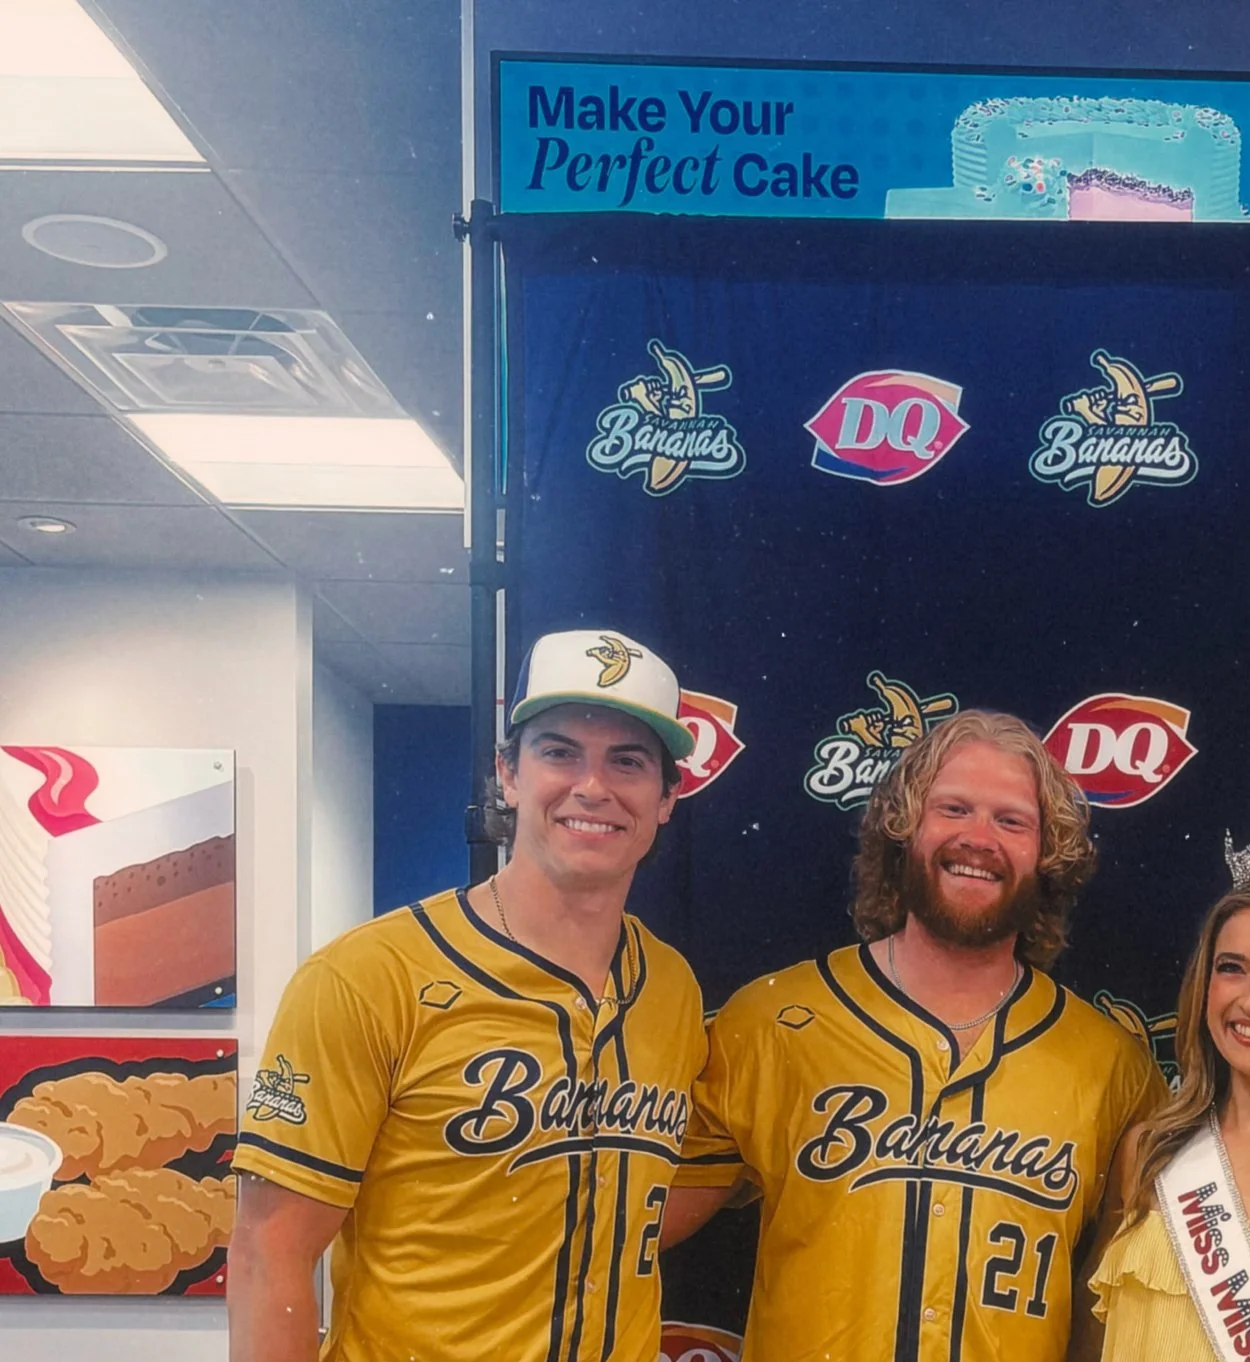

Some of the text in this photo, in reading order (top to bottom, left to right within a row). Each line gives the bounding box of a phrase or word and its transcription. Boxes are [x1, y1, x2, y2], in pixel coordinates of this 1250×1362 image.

[529, 85, 794, 136] Make Your
[525, 136, 860, 208] Perfect Cake
[591, 408, 738, 471] Bananas
[642, 414, 720, 430] SAVANNAH
[835, 397, 941, 459] DQ
[1034, 420, 1190, 482] Bananas
[1086, 426, 1172, 436] SAVANNAH
[1063, 722, 1171, 783] DQ
[444, 1046, 689, 1176] Bananas
[796, 1083, 1080, 1212] Bananas
[1178, 1181, 1232, 1275] Miss
[980, 1221, 1057, 1319] 21
